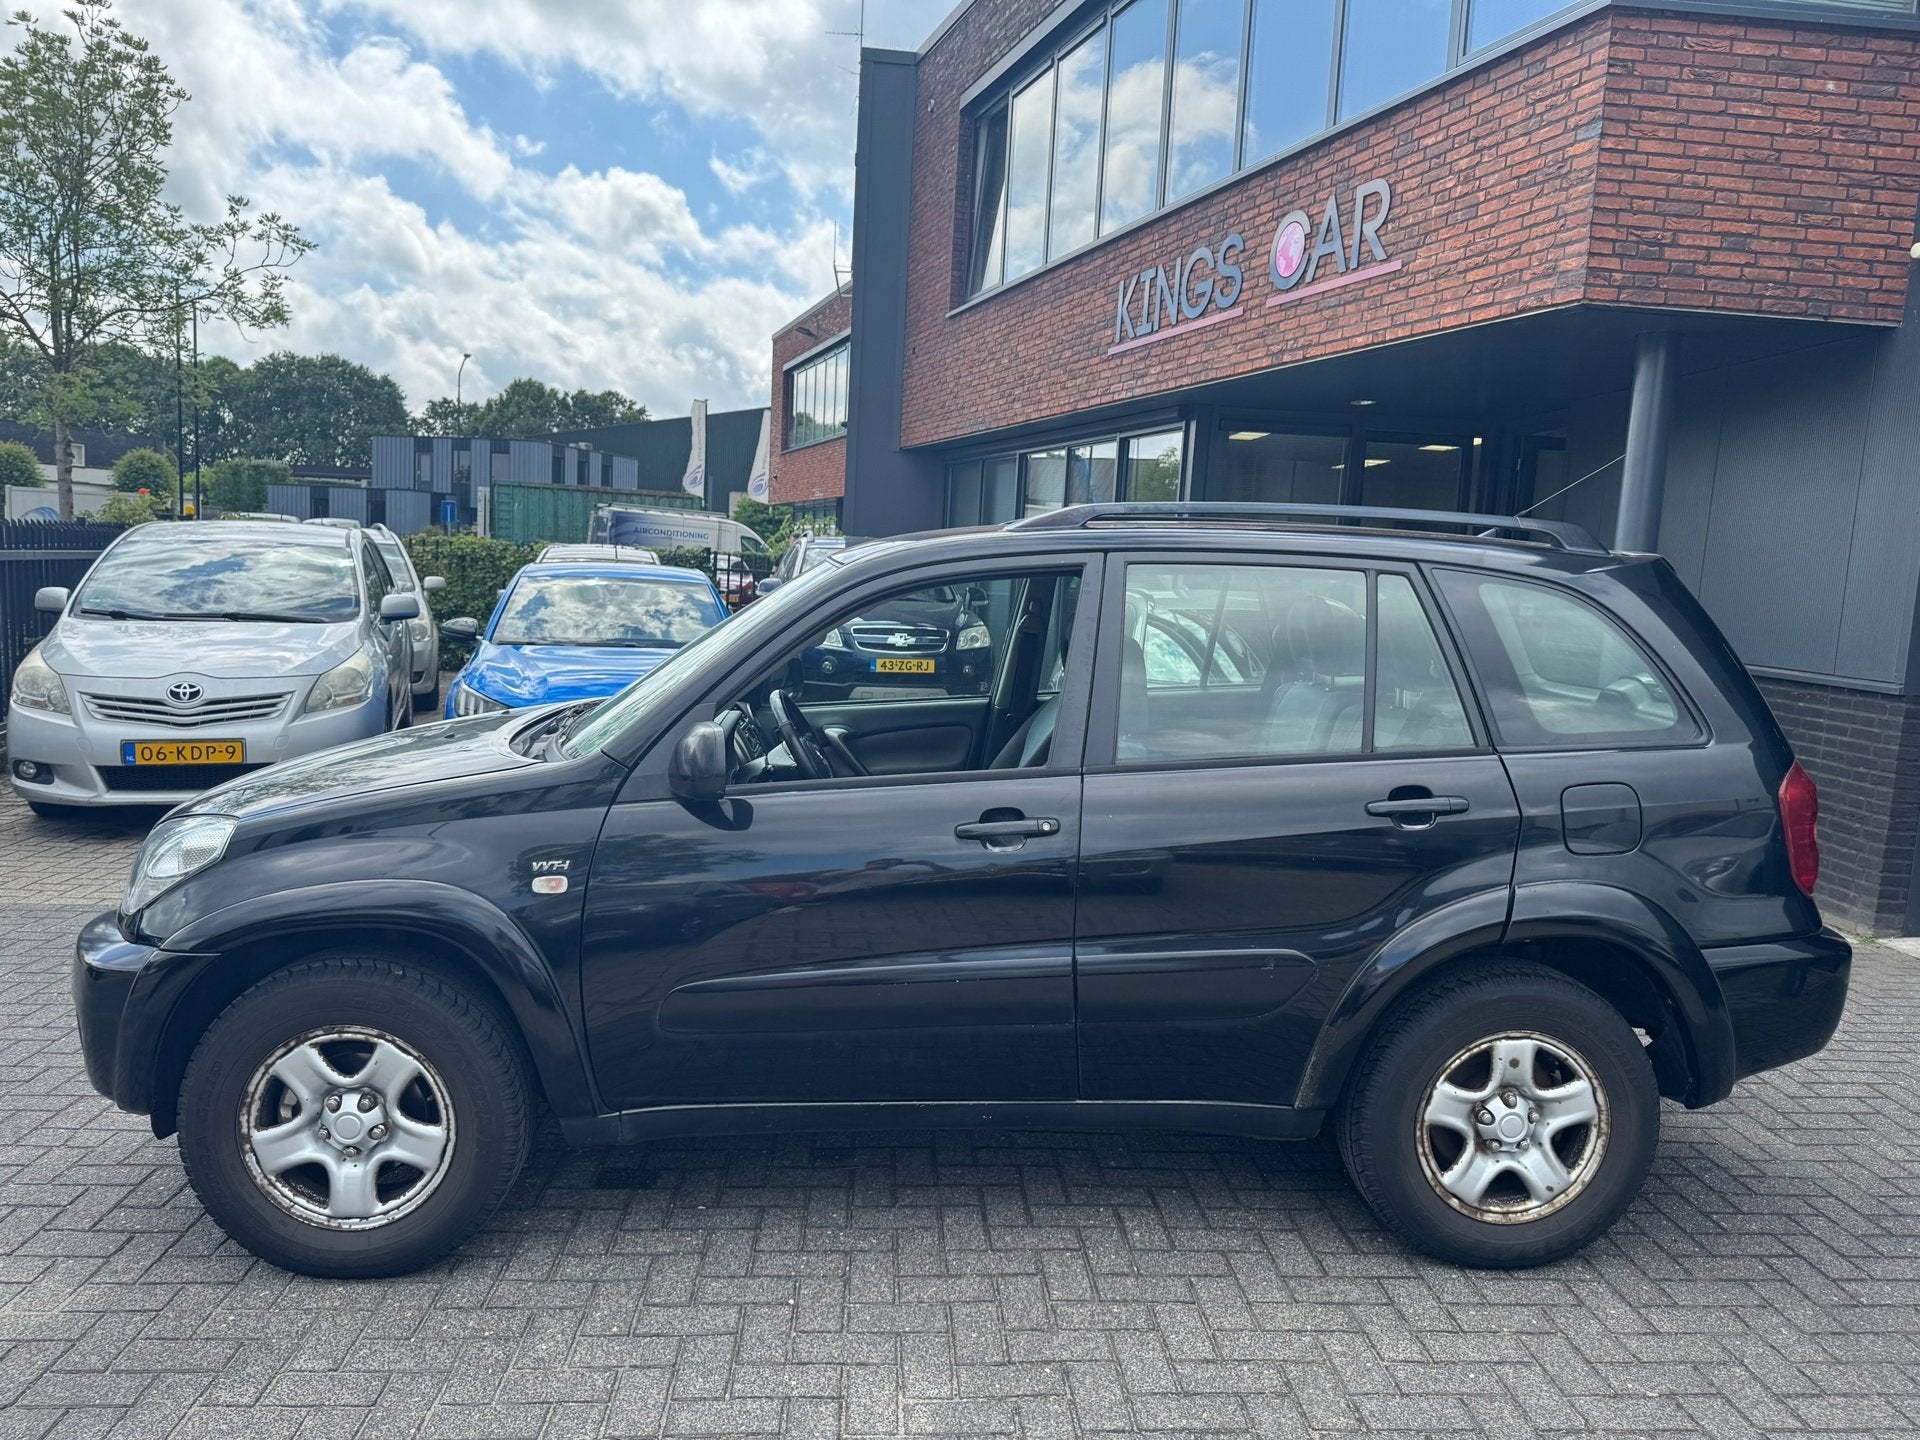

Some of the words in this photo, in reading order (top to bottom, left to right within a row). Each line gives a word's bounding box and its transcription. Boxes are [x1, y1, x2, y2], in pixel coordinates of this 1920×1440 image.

[1115, 233, 1246, 343] KINGS
[1269, 178, 1392, 290] CAR
[633, 526, 709, 540] AIRCONDITIONING
[880, 660, 929, 671] 43-ZG-RJ
[140, 745, 236, 761] 06-KDP-9
